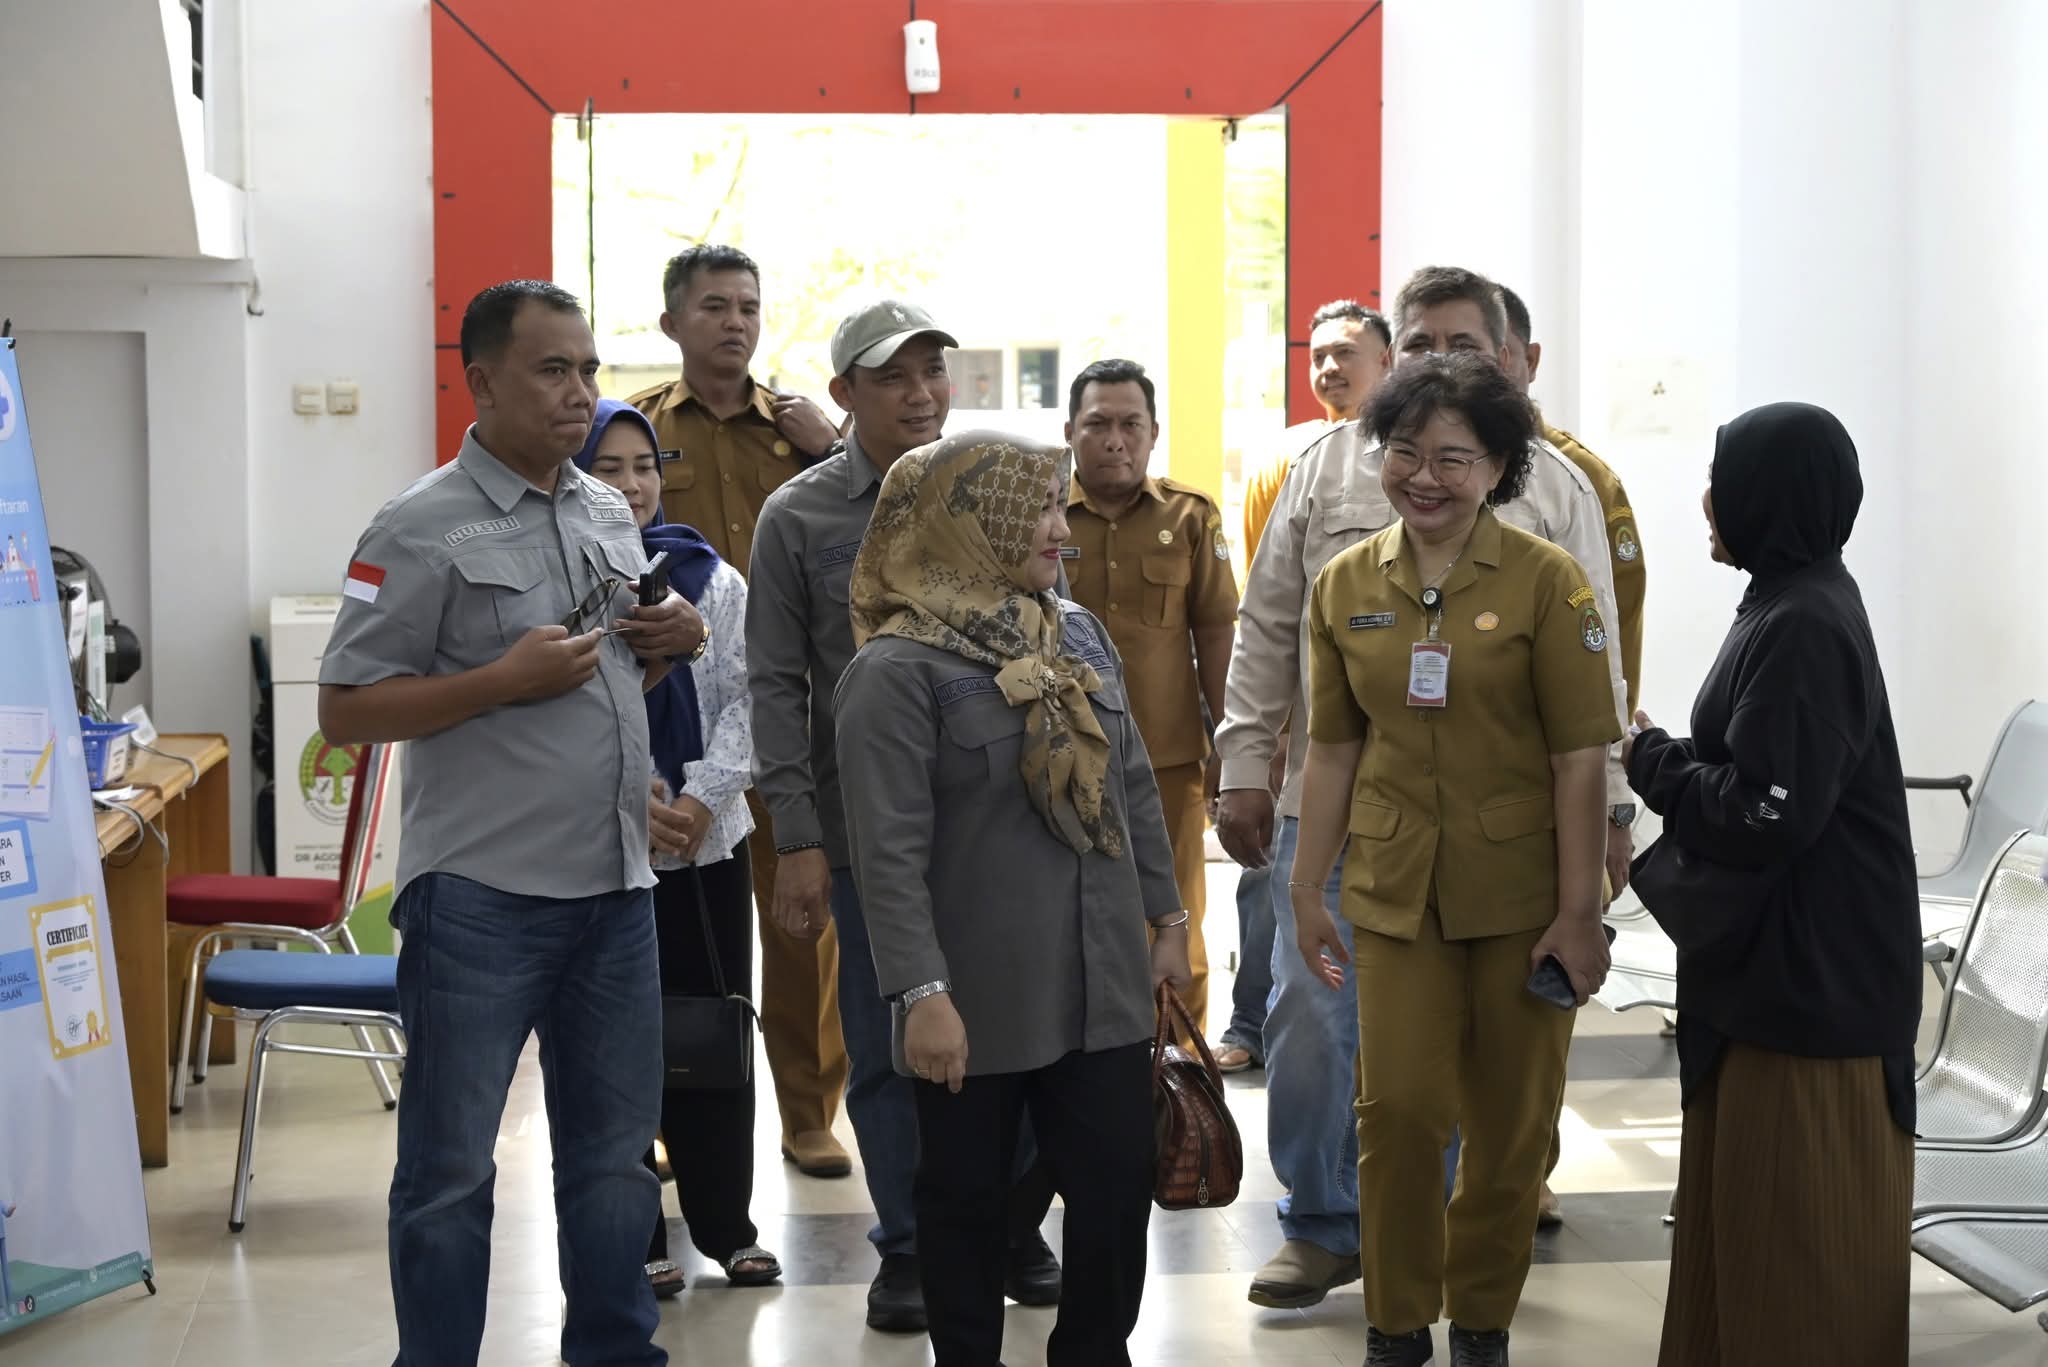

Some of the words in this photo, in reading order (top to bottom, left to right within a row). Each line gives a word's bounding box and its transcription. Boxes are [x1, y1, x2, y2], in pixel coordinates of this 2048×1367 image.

[450, 517, 515, 542] NURSIRI
[0, 837, 13, 850] RA
[0, 870, 12, 882] ER
[46, 923, 89, 946] CERTIFICATE
[0, 988, 23, 1002] SAAN
